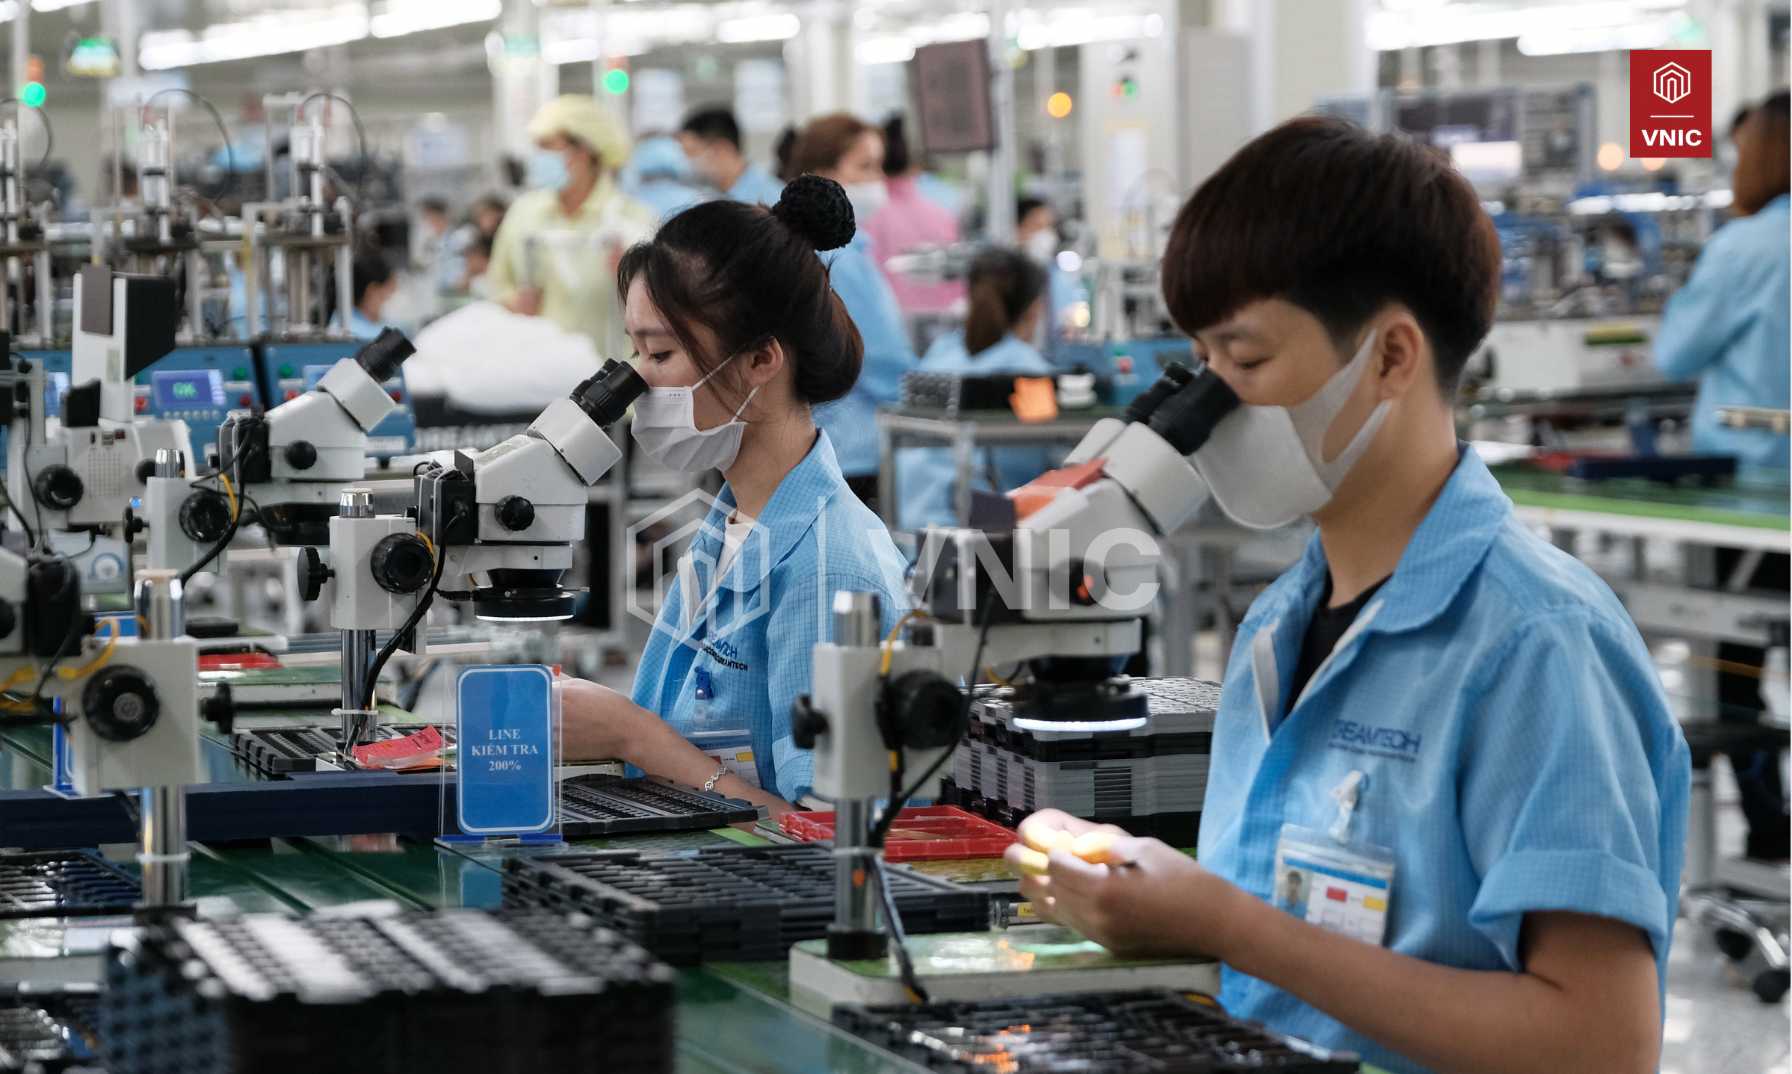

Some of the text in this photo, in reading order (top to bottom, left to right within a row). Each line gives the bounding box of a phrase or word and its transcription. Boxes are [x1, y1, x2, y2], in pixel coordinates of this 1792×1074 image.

[489, 729, 520, 740] LINE
[511, 744, 538, 755] TRA
[489, 760, 521, 771] 200%
